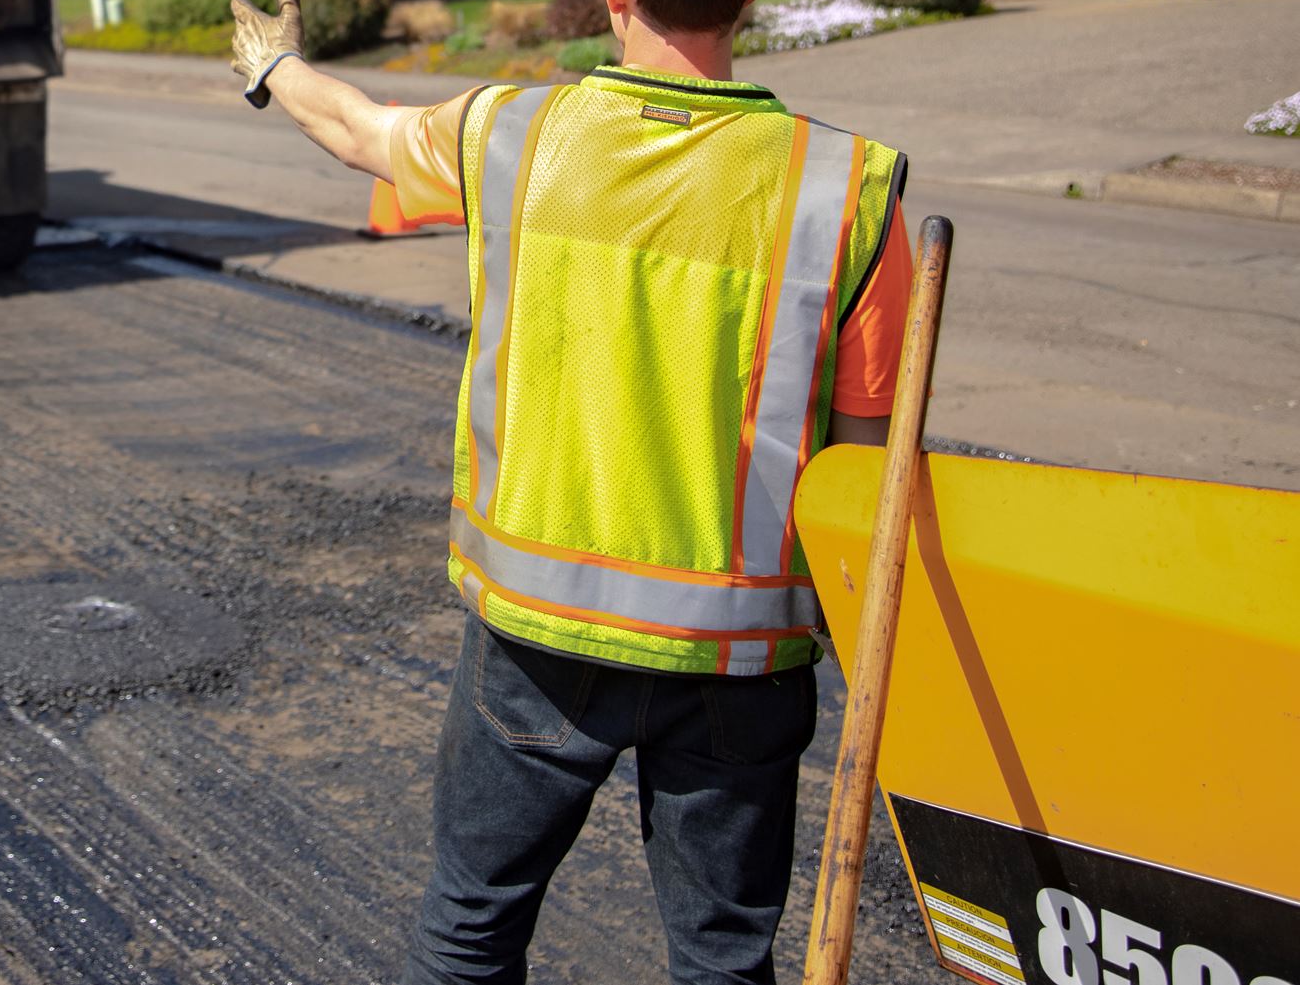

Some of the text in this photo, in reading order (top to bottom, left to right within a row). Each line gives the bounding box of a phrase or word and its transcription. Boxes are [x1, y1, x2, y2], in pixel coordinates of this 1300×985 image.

[947, 896, 983, 916] CAUTION
[1036, 887, 1300, 985] 85
[957, 944, 1002, 969] ATTENTION
